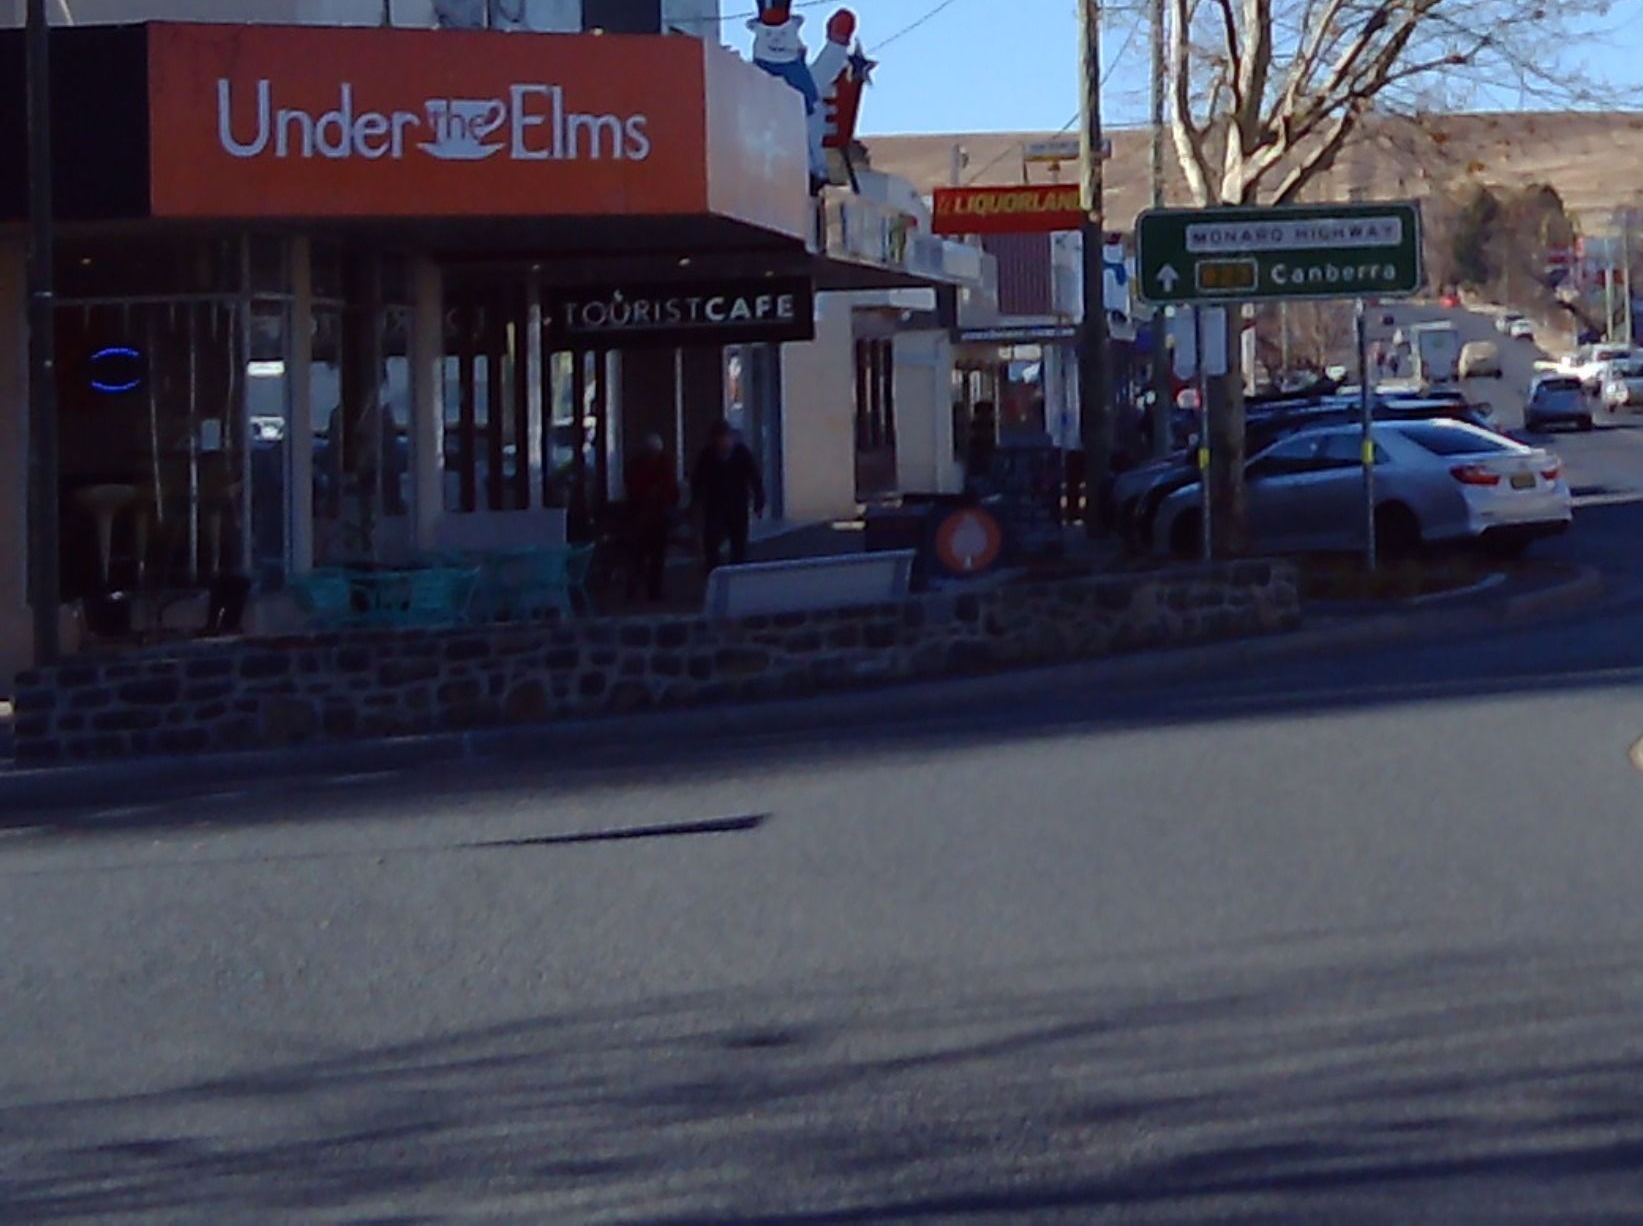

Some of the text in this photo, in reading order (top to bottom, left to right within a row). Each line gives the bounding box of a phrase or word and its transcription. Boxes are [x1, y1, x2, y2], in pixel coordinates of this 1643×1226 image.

[217, 78, 420, 159] Under
[509, 84, 650, 160] Elms
[1192, 224, 1394, 244] MONARO HIGHWAY
[1271, 263, 1396, 285] Canberra
